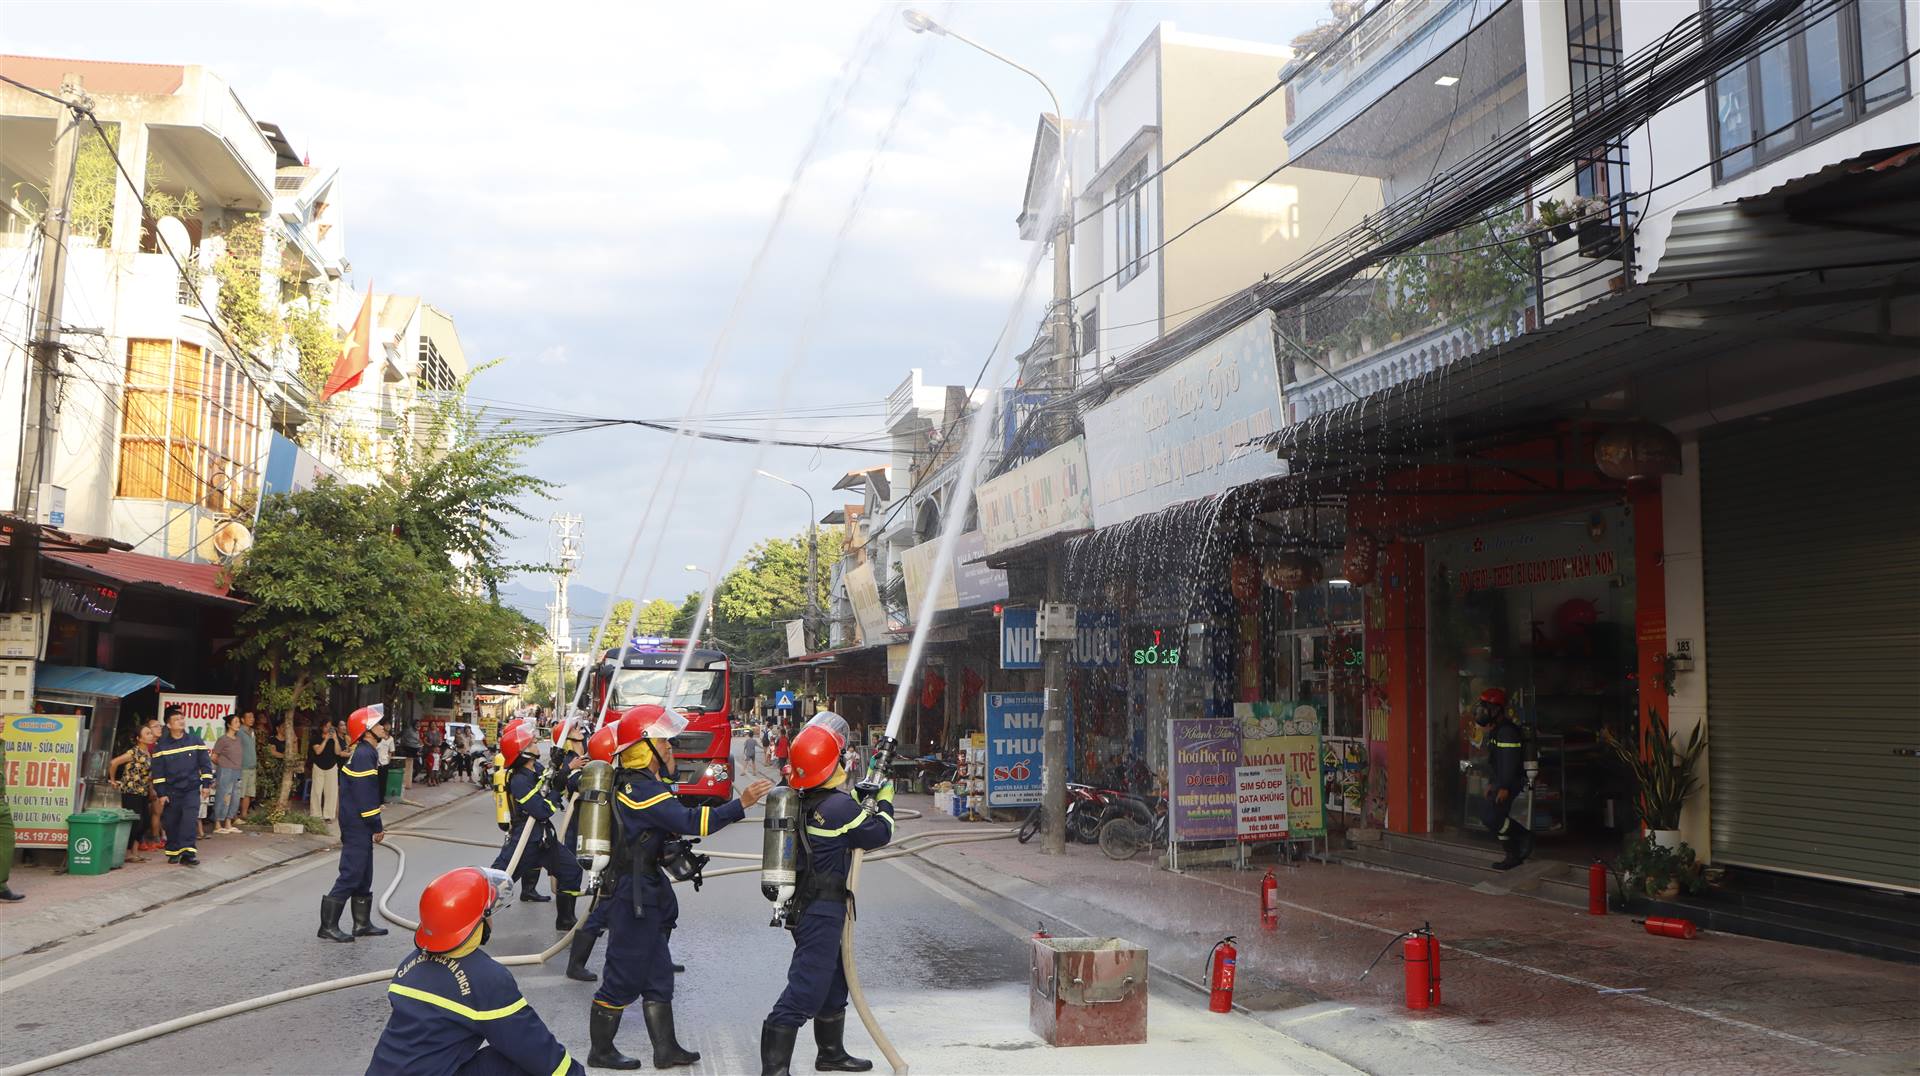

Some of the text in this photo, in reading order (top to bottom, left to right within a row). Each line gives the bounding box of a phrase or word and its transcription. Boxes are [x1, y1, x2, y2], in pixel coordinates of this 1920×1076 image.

[1595, 551, 1614, 576] NON
[1134, 645, 1179, 664] SỐ 15
[1677, 641, 1690, 652] 183
[5, 742, 15, 751] UA
[1178, 747, 1237, 766] Hoa Học Trò
[1289, 744, 1317, 780] TRẺ
[26, 758, 71, 792] ĐIỆN
[1240, 778, 1282, 791] SIM SỐ ĐẸP
[1239, 794, 1258, 803] DATA
[454, 969, 472, 997] CNCH
